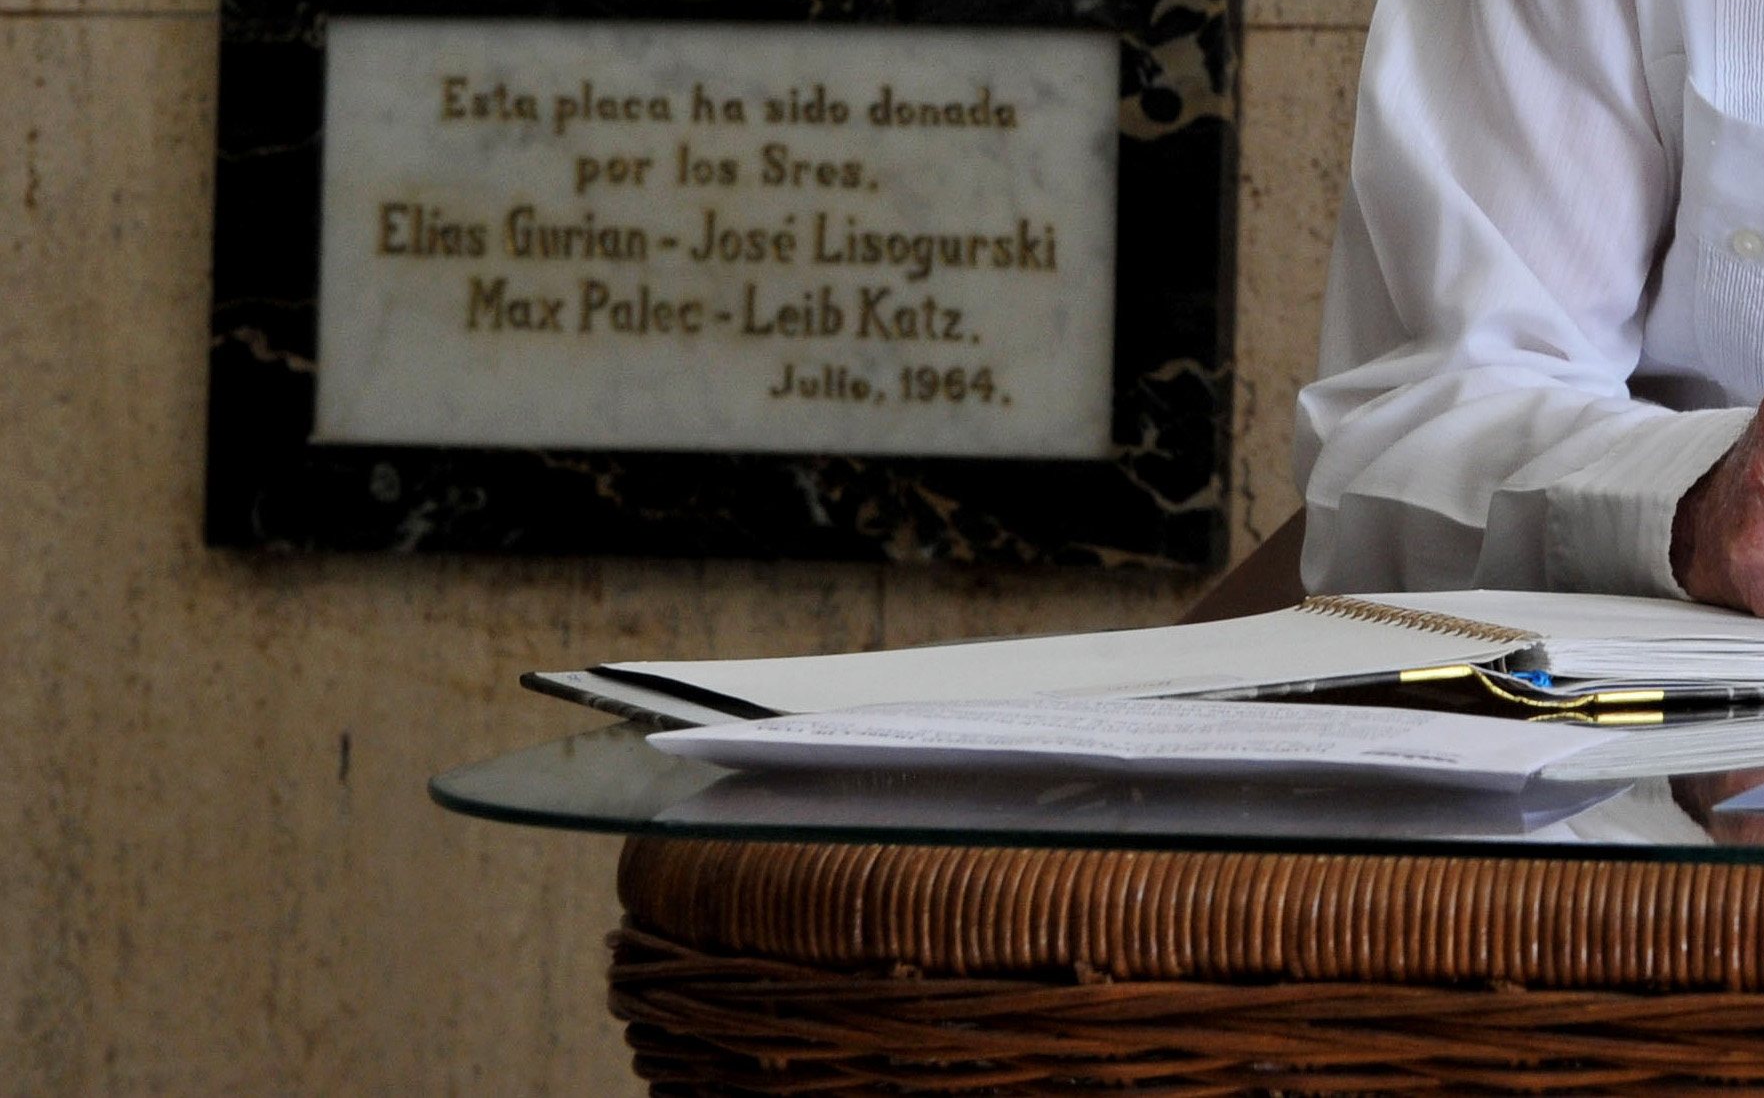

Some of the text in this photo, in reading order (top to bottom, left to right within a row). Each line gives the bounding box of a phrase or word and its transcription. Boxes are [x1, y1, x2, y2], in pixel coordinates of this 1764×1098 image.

[437, 76, 1018, 137] Esta placa ha sido donada
[573, 142, 880, 195] por los Sres.
[374, 202, 490, 260] Elias
[810, 213, 1060, 281] Lisogurski
[465, 275, 566, 332] Max
[854, 285, 983, 347] Katz.
[899, 365, 1013, 406] 1964.
